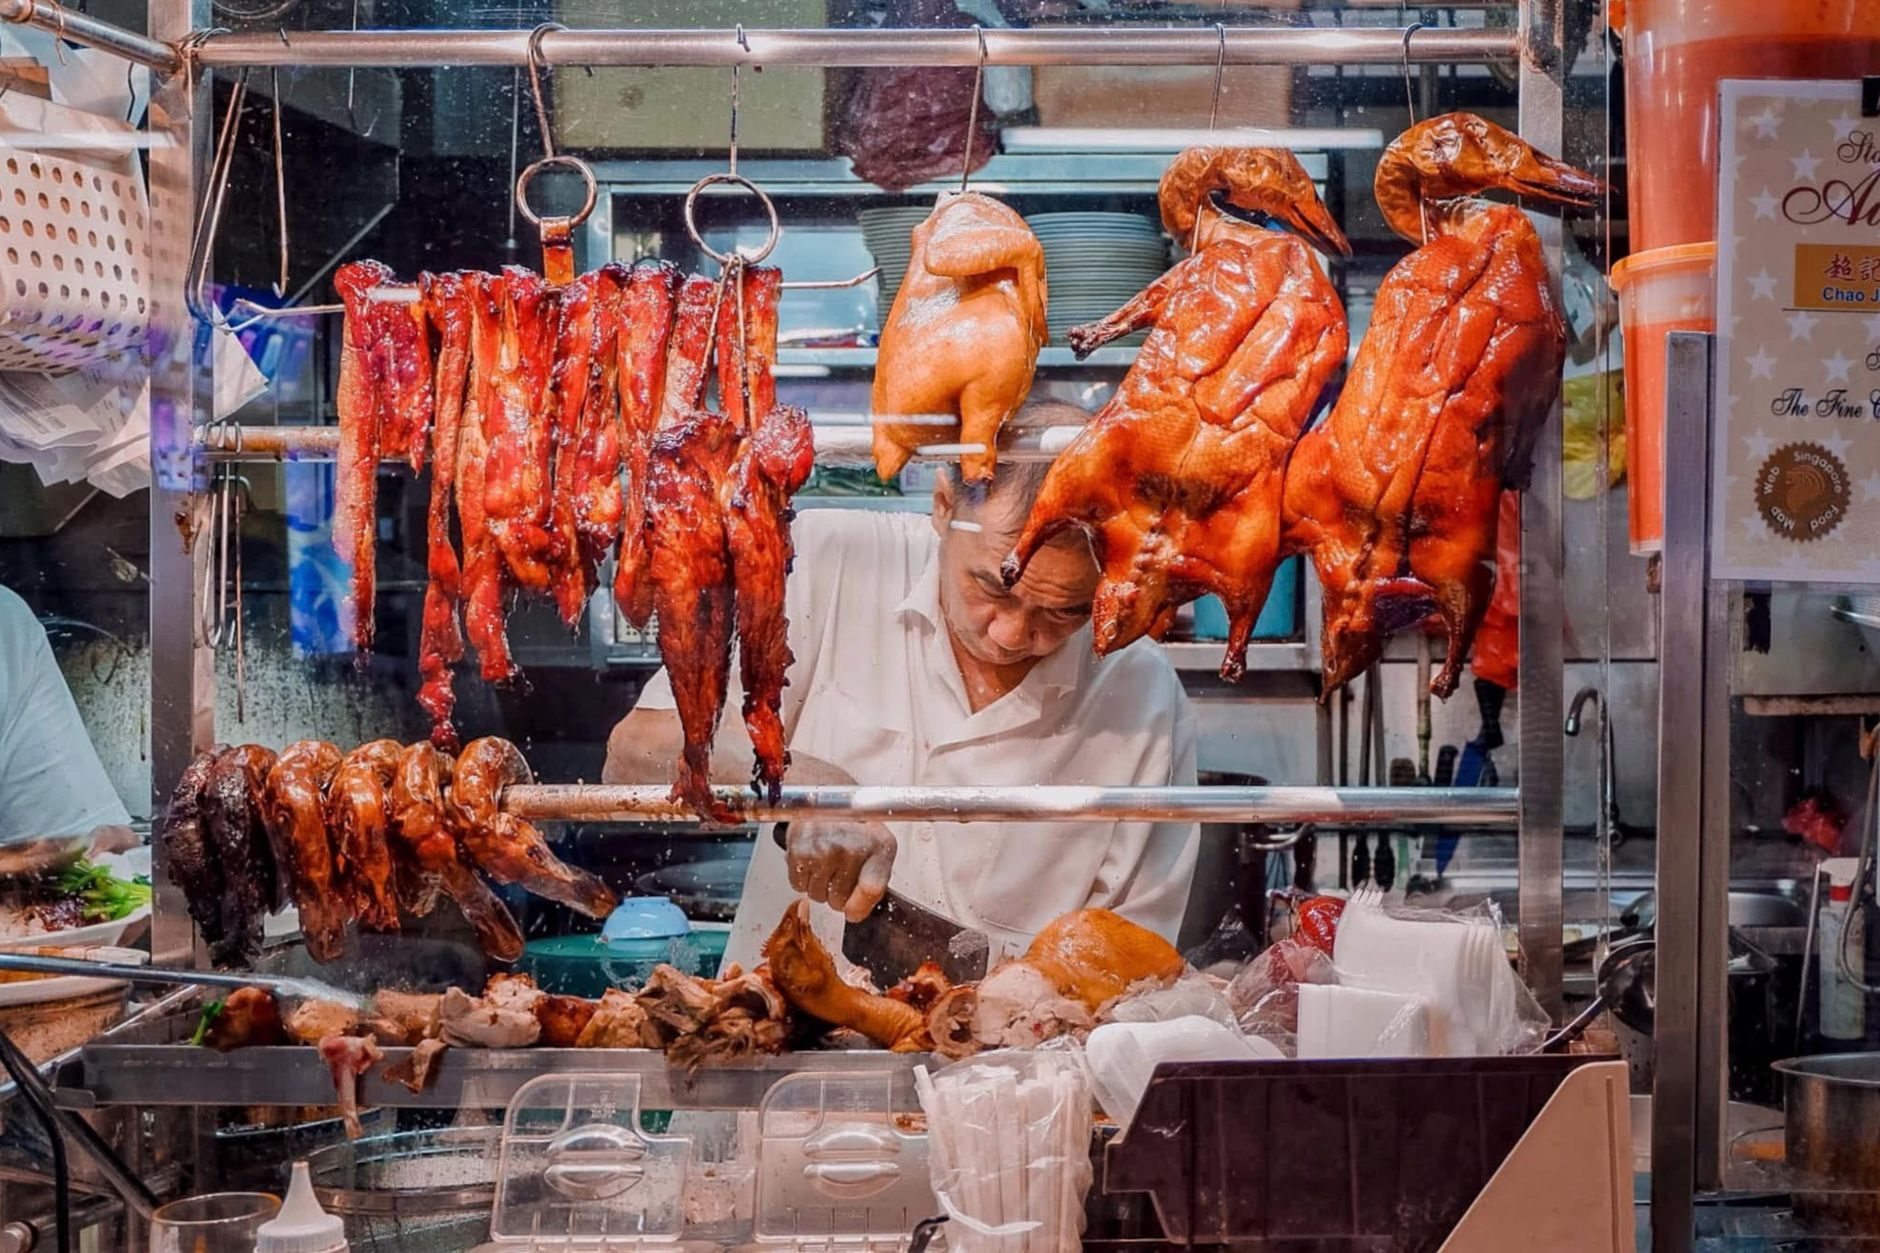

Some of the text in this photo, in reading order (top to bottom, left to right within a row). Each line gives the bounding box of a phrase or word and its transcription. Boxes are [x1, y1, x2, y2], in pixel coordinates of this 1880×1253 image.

[1823, 286, 1865, 302] Chao
[1771, 387, 1809, 417] The
[1815, 389, 1862, 418] Fine
[1762, 450, 1842, 531] Singapore Food Map Web
